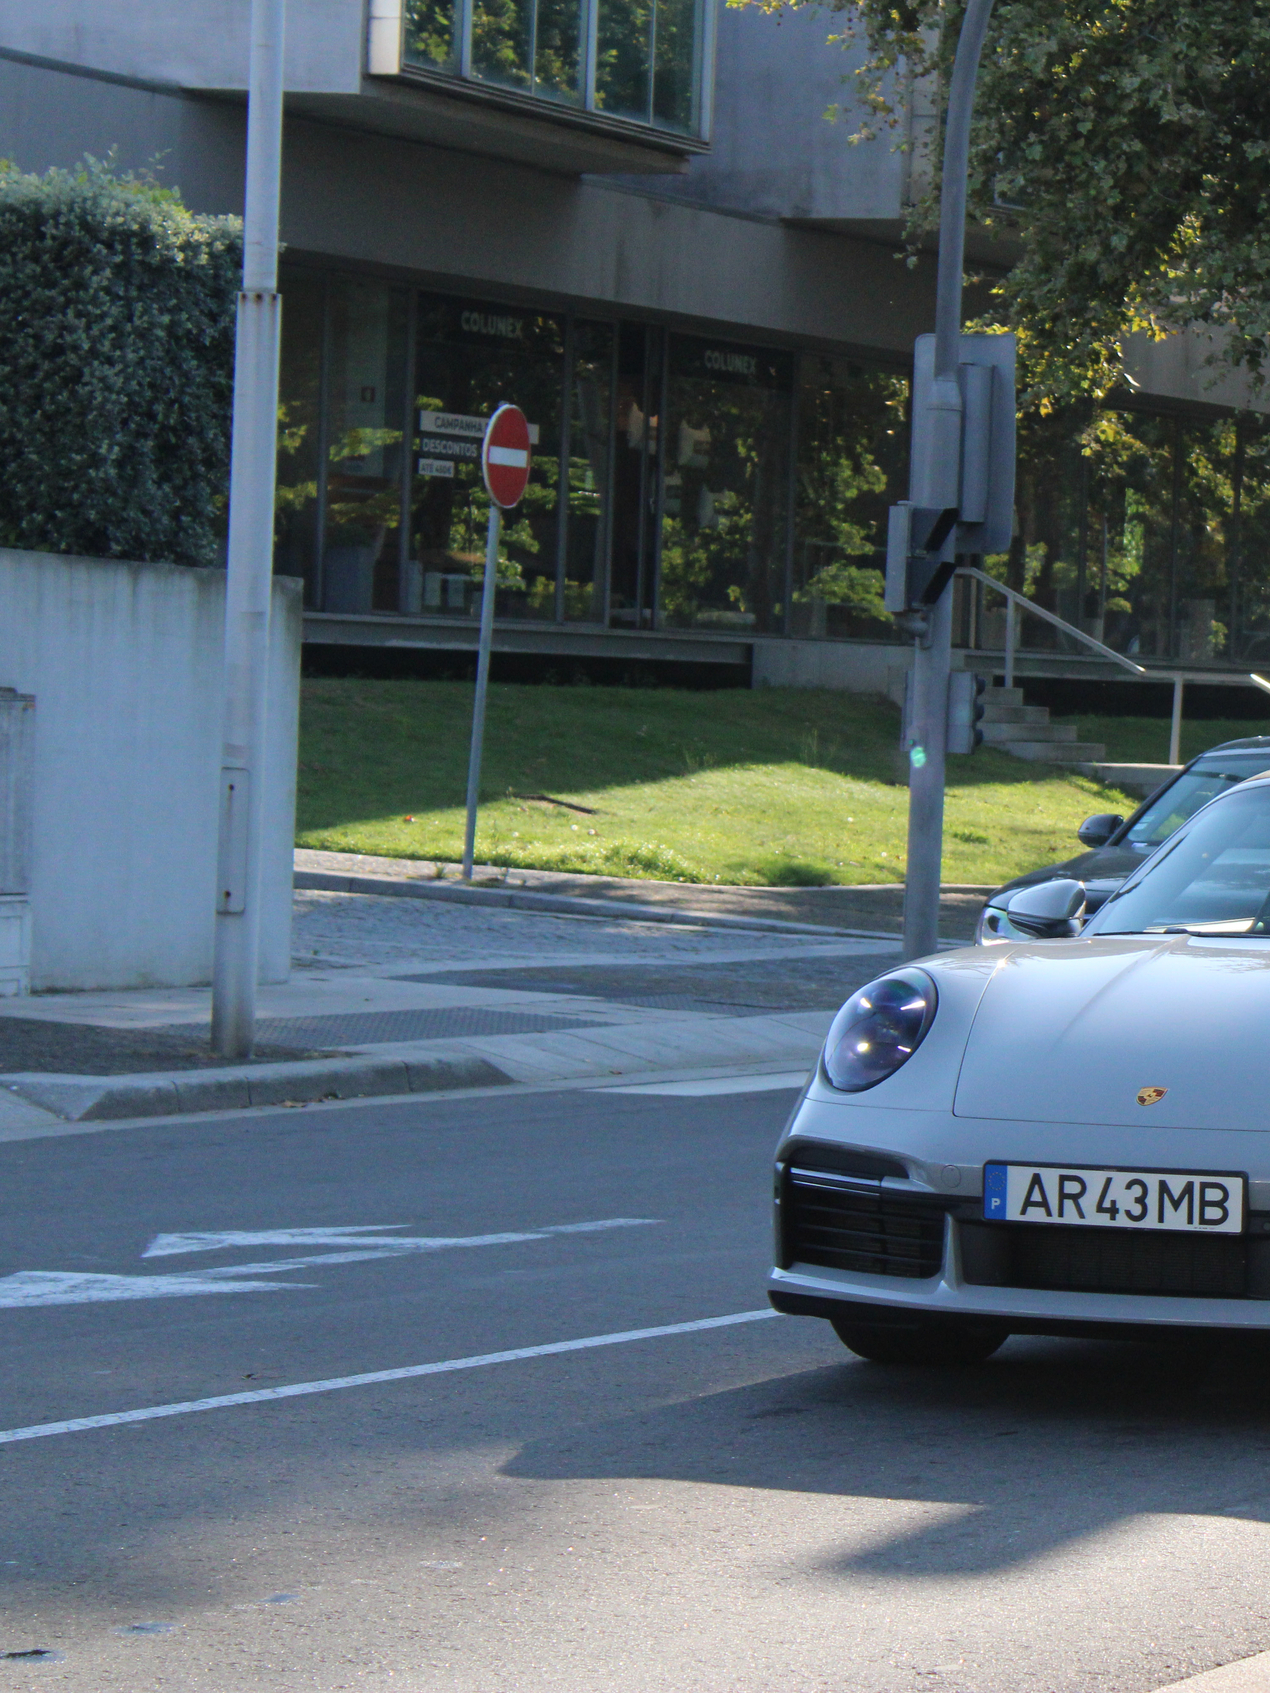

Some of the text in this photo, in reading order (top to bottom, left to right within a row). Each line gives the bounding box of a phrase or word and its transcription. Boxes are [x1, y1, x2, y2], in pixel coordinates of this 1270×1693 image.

[461, 310, 523, 339] COLUNEX
[704, 349, 757, 375] COLUNEX
[434, 416, 483, 433] CAMPANHA
[422, 437, 478, 457] DESCONTOS
[991, 1197, 1001, 1210] P
